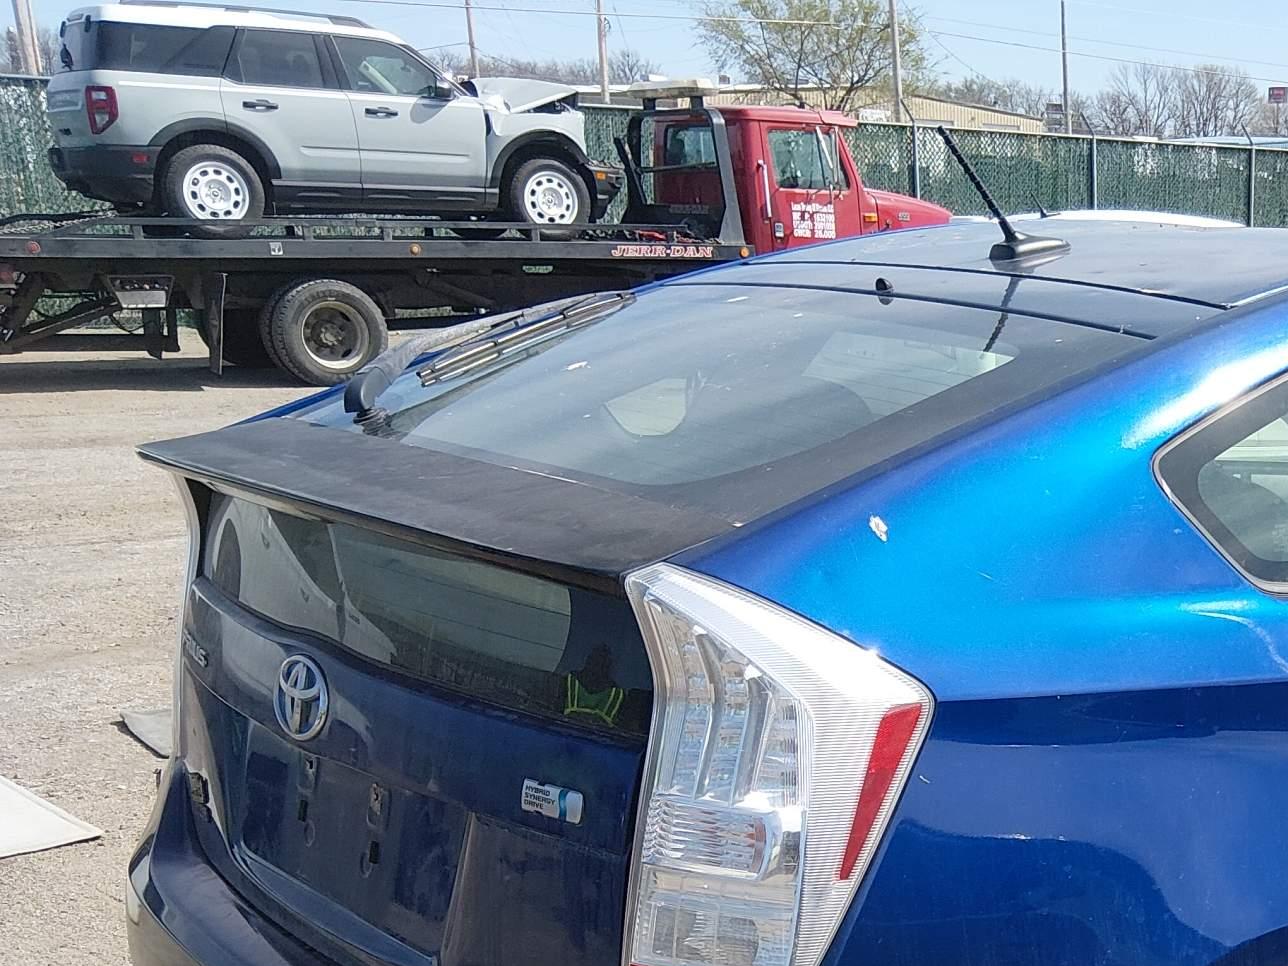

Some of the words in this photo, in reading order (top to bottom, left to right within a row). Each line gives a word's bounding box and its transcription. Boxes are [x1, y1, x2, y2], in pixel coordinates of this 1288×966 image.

[612, 246, 713, 257] JERR-DAN
[525, 785, 550, 797] HYBRID
[524, 791, 556, 805] SYNERGY
[524, 799, 544, 810] DRIVE
